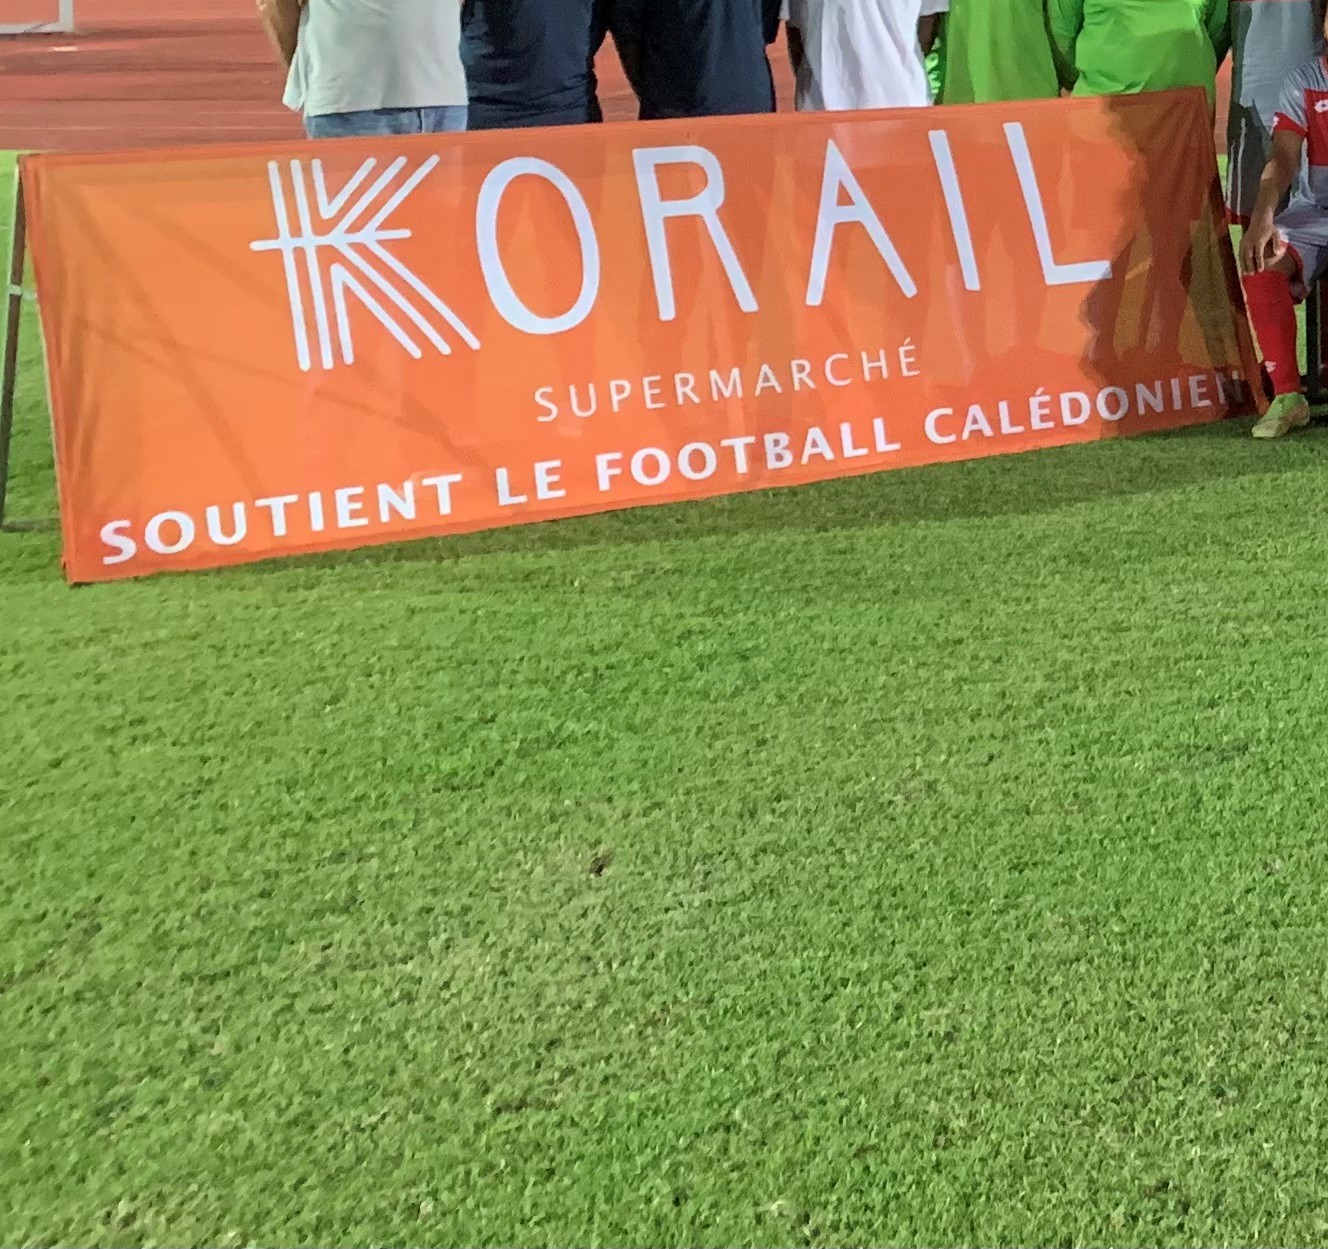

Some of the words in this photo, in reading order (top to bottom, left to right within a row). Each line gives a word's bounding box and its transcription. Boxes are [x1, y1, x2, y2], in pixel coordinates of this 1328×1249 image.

[250, 121, 1111, 371] KORAIL
[100, 473, 464, 565] SOUTIENT
[495, 460, 566, 506] LE
[595, 417, 902, 492] FOOTBALL
[924, 370, 1243, 444] CALÉDONIEN
[534, 338, 921, 423] SUPERMARCHÉ
